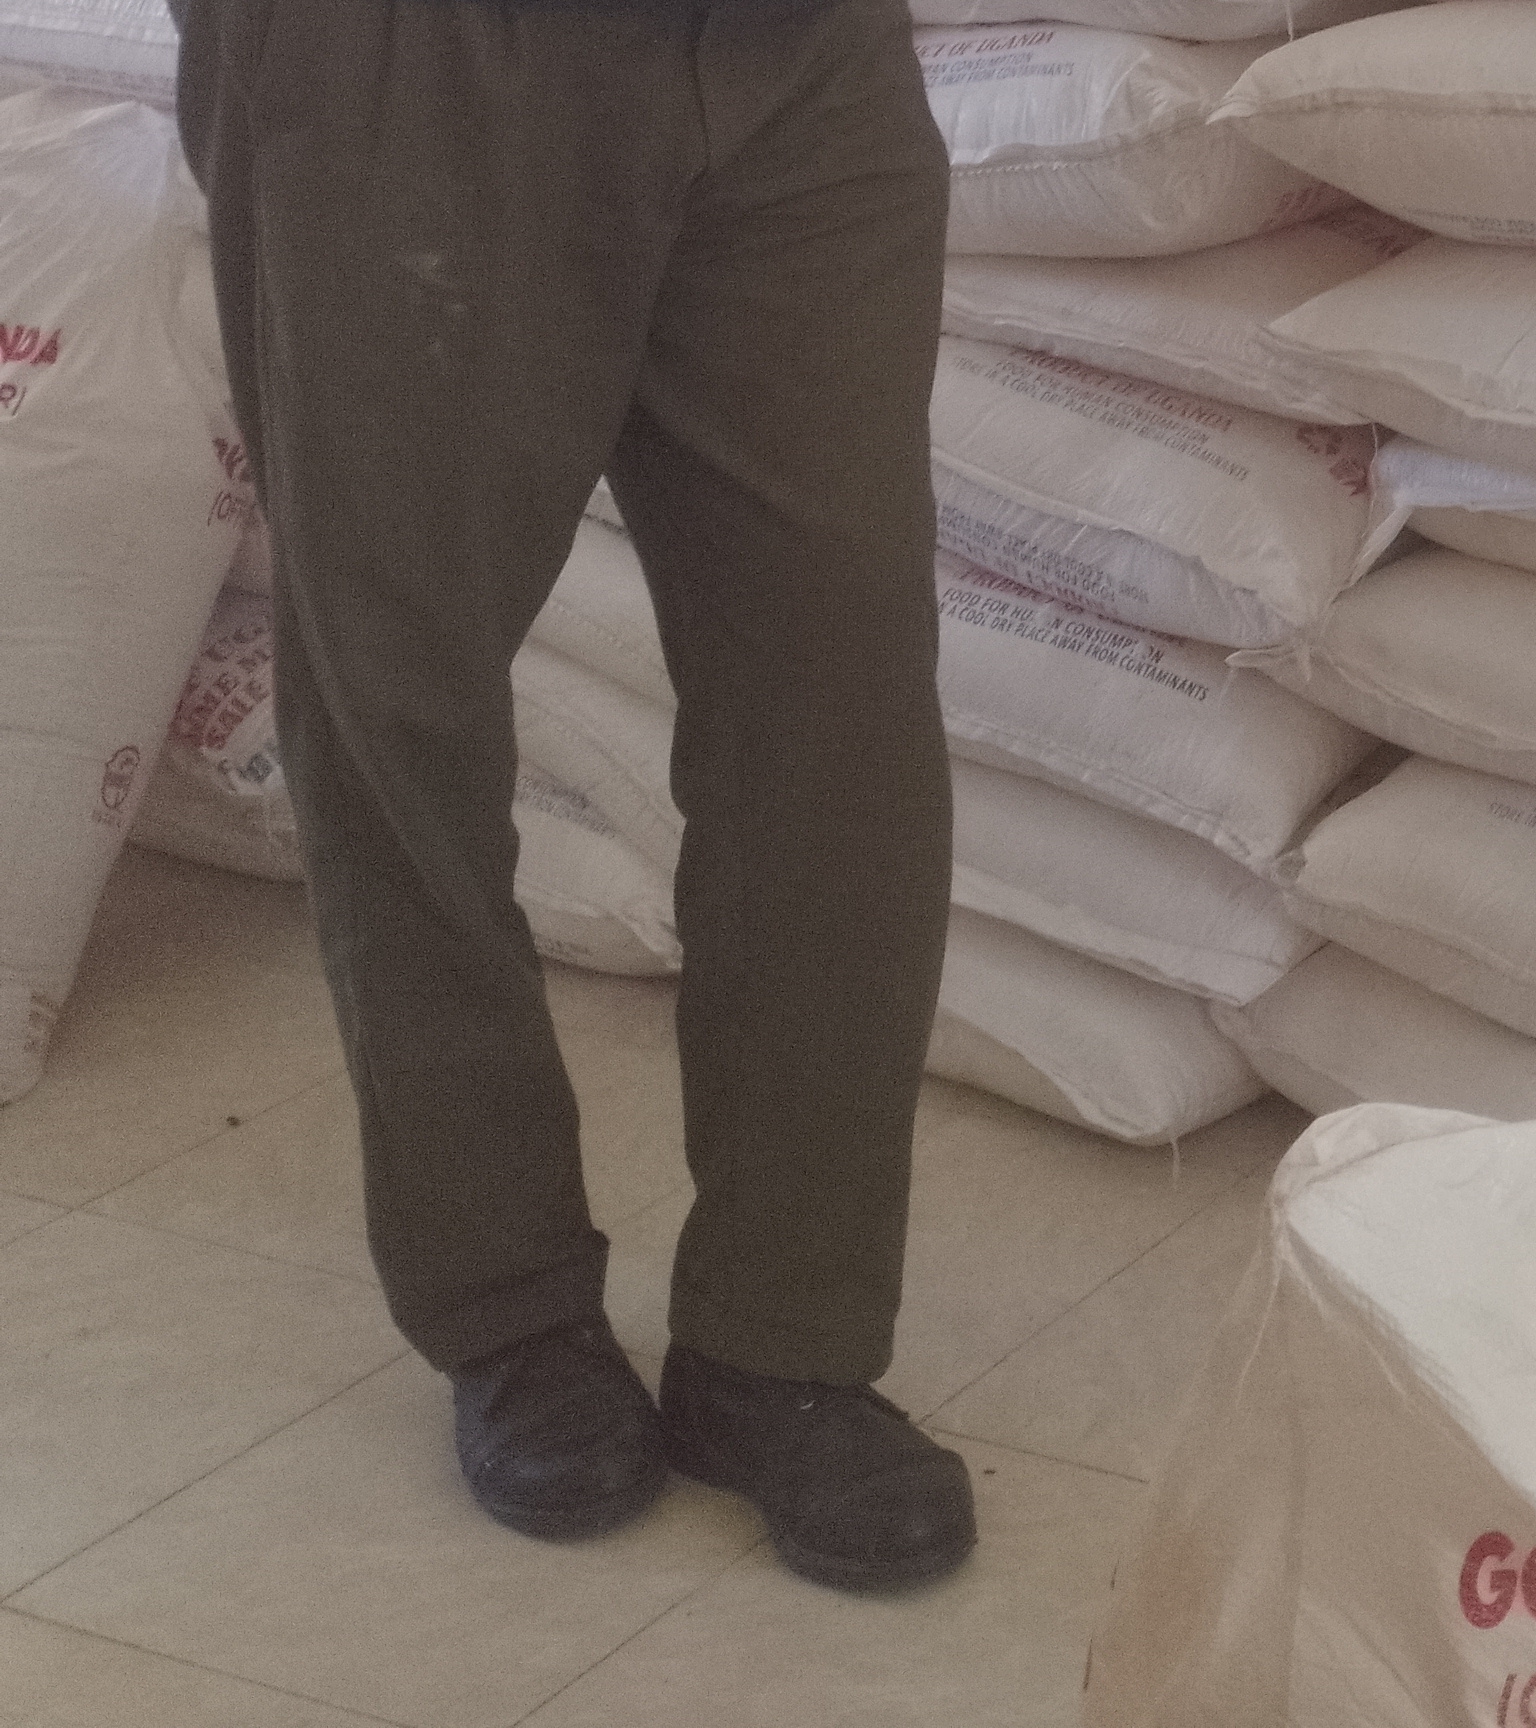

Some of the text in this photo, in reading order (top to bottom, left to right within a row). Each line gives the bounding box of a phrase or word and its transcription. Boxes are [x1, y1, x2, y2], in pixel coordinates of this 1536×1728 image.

[943, 587, 981, 607] FOOD
[981, 597, 1008, 617] FOR
[947, 604, 1210, 702] A COOL DRY PLACE AWAY FROM CONTAMINANTS
